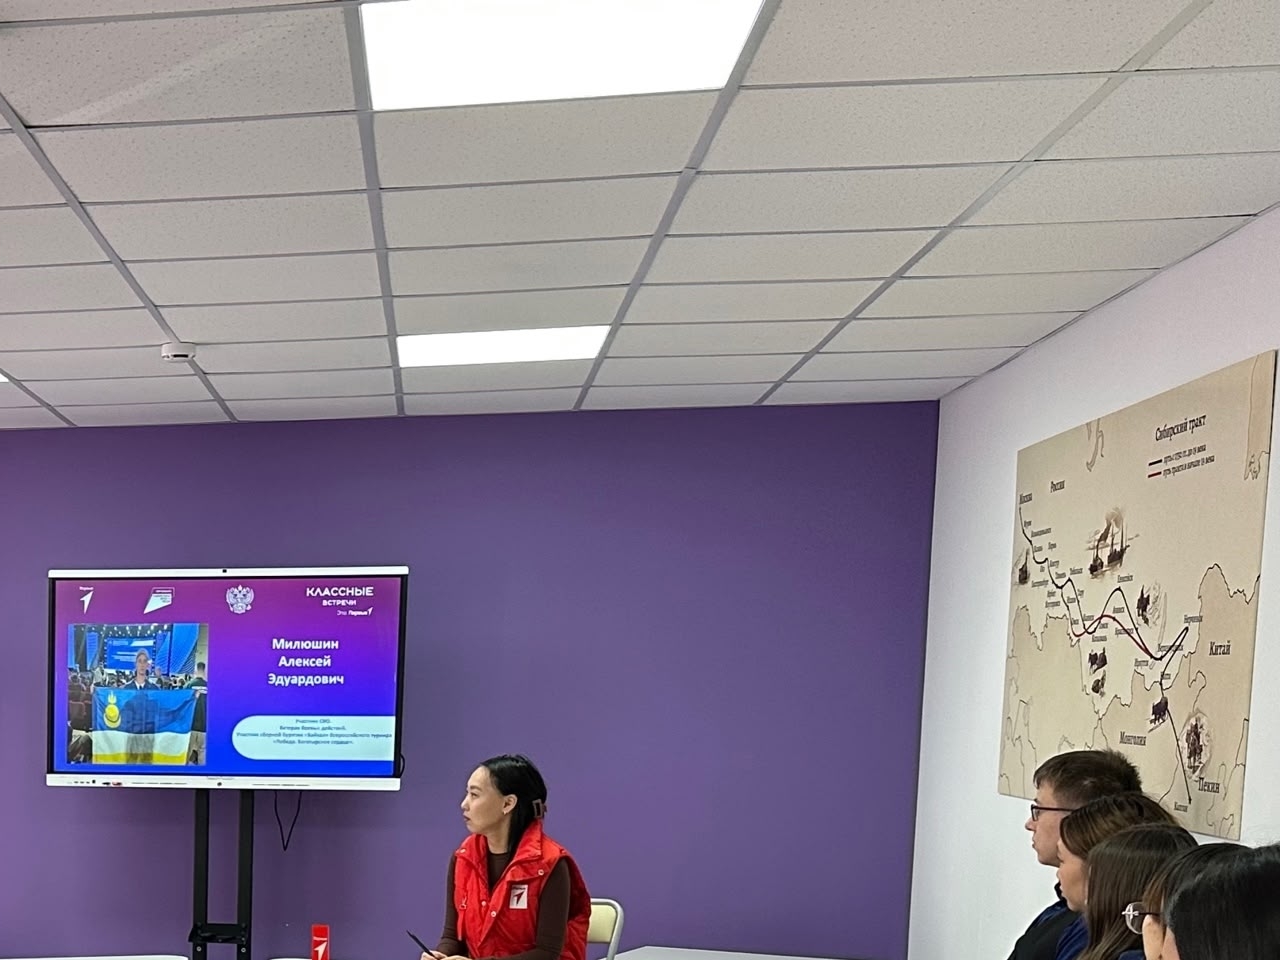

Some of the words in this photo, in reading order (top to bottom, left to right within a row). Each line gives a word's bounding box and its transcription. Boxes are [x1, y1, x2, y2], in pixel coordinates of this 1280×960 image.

[1156, 418, 1188, 441] Сибирский
[1189, 414, 1207, 434] тракт
[306, 587, 374, 597] КЛАССНЫЕ
[272, 638, 339, 649] Милюшин
[1209, 640, 1231, 656] Китай
[278, 655, 332, 667] Алексей
[268, 673, 344, 686] Эдуардович
[1119, 731, 1147, 746] Монголия
[1198, 777, 1220, 794] Пекин
